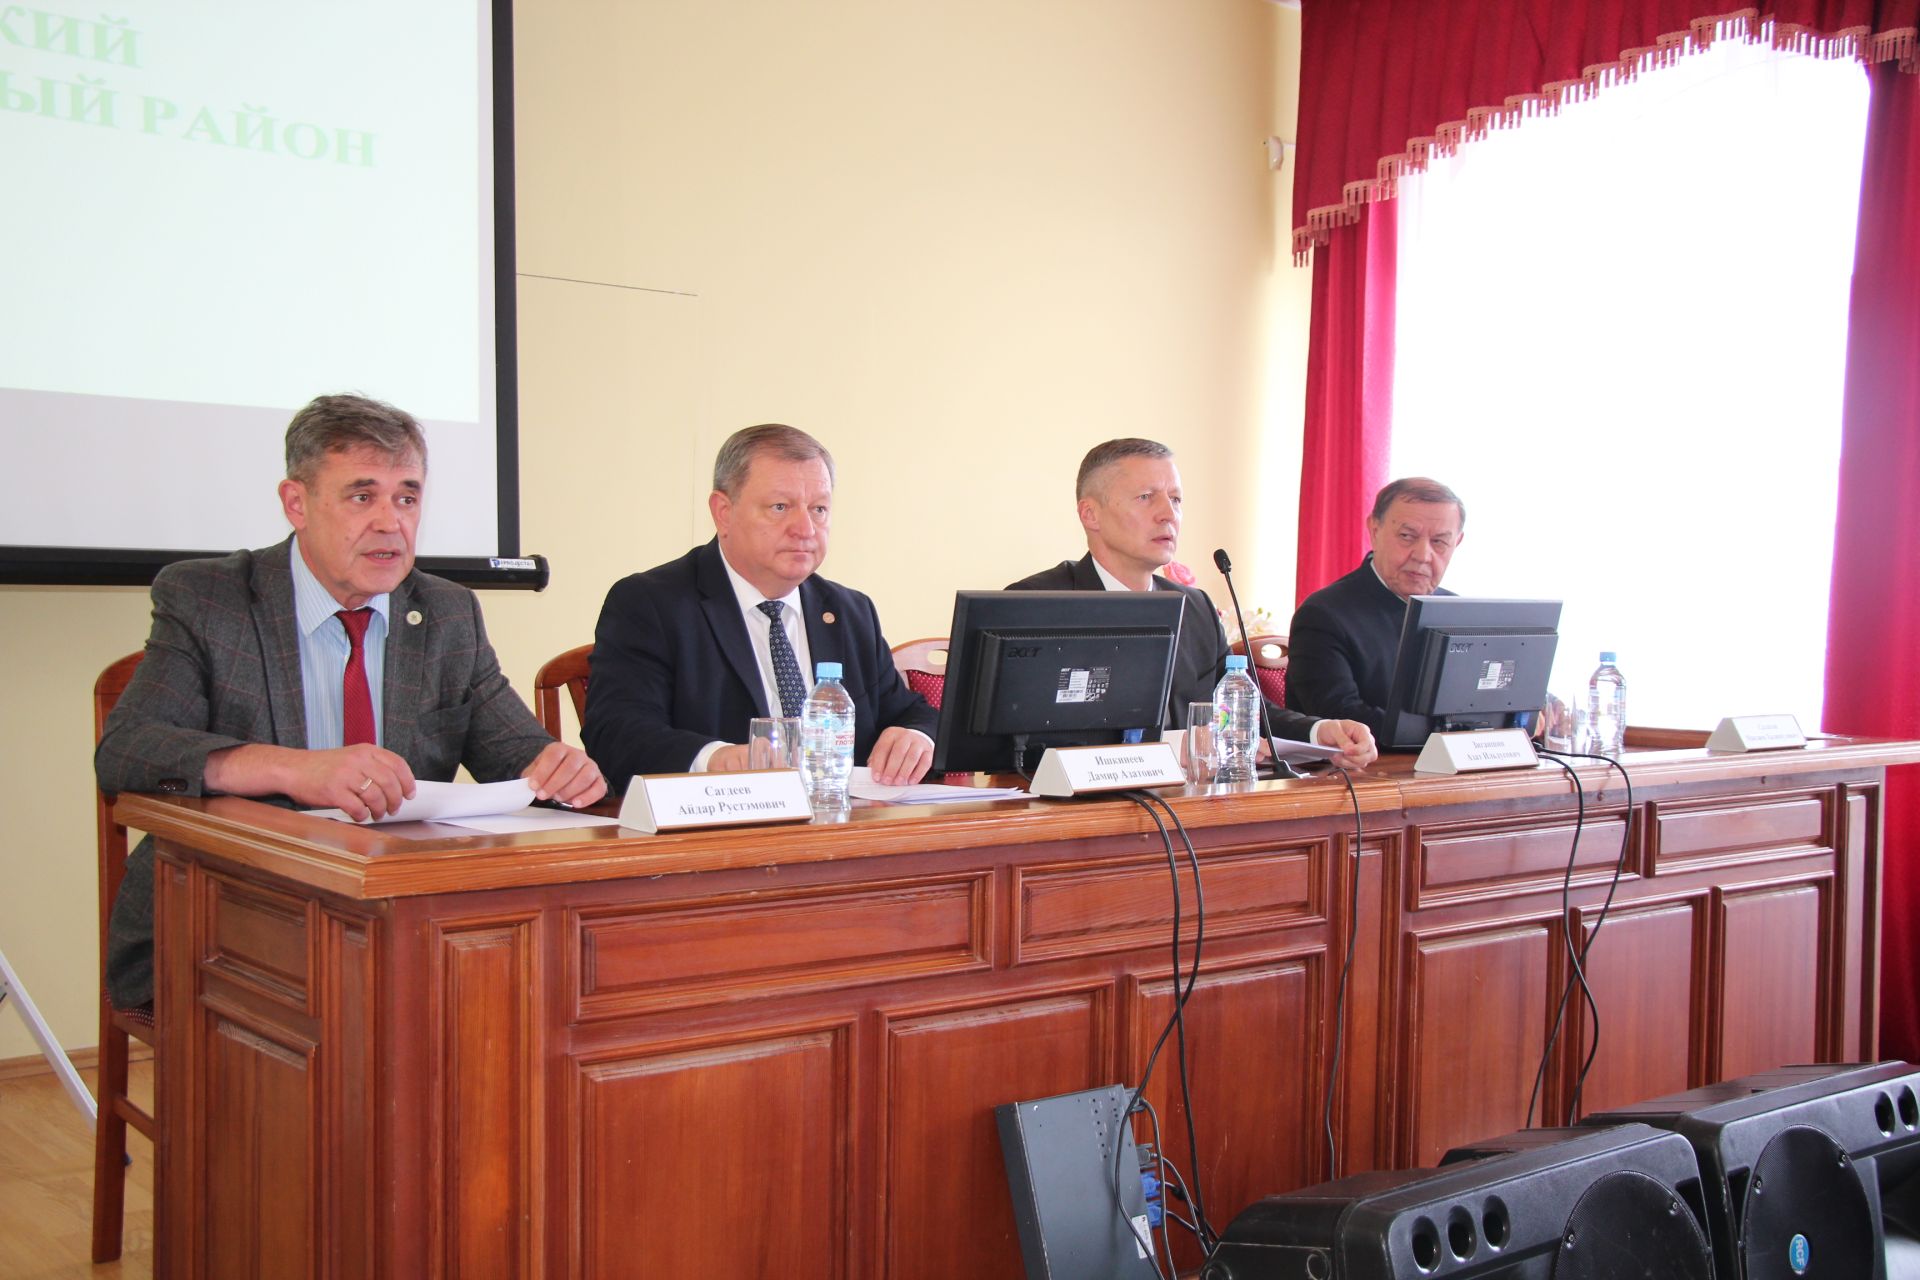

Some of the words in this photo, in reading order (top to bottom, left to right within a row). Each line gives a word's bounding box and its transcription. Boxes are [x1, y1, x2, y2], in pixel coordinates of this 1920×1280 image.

[138, 95, 380, 169] РАЙОН
[1007, 647, 1043, 658] acer
[1449, 642, 1474, 653] acer
[1094, 755, 1145, 766] Ишкинеев
[1088, 770, 1119, 783] Дамир
[1121, 768, 1165, 779] Азатович
[704, 785, 752, 797] Сагдеев
[679, 804, 716, 816] Айдар
[718, 800, 786, 814] Рустэмович
[1795, 1239, 1804, 1265] RCF
